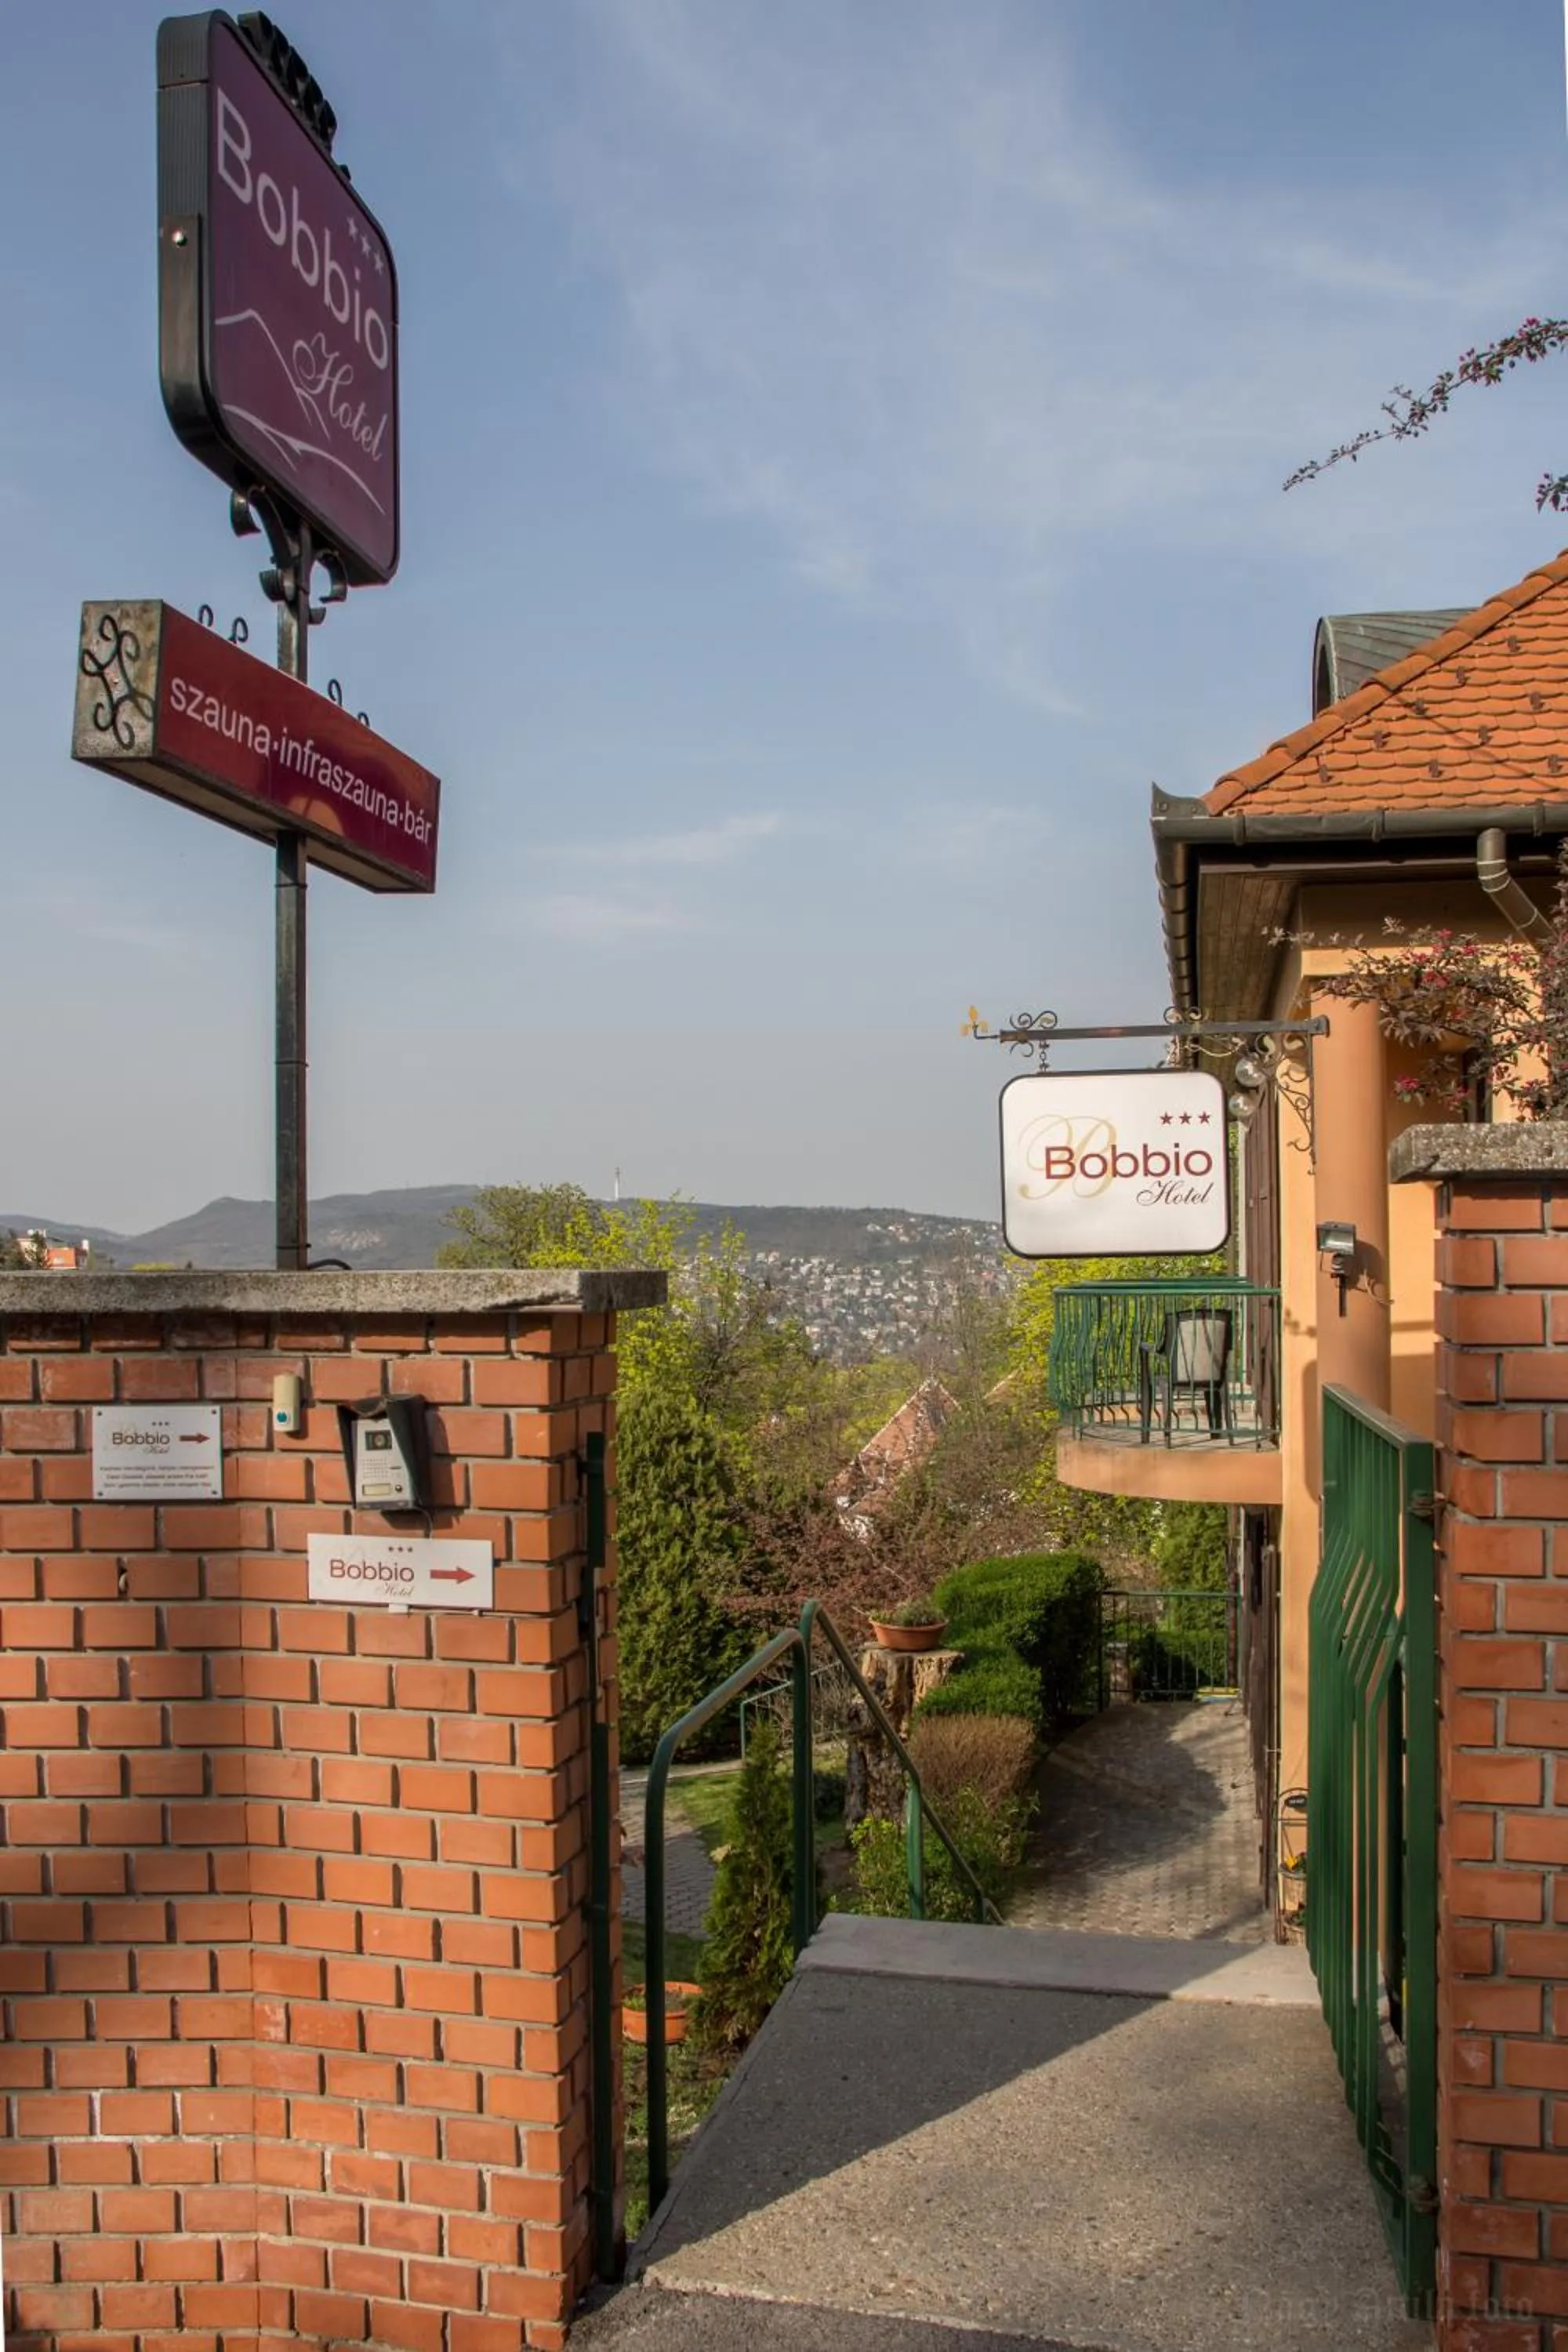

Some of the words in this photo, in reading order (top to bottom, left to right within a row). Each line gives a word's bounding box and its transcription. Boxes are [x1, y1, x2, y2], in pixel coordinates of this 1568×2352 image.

[216, 88, 389, 370] Bobbio
[292, 332, 387, 463] Hotel
[1044, 1142, 1214, 1180] Bobbio
[1136, 1180, 1214, 1207] Hotel
[112, 1432, 171, 1446] Bobbio
[329, 1559, 416, 1583] Bobbio
